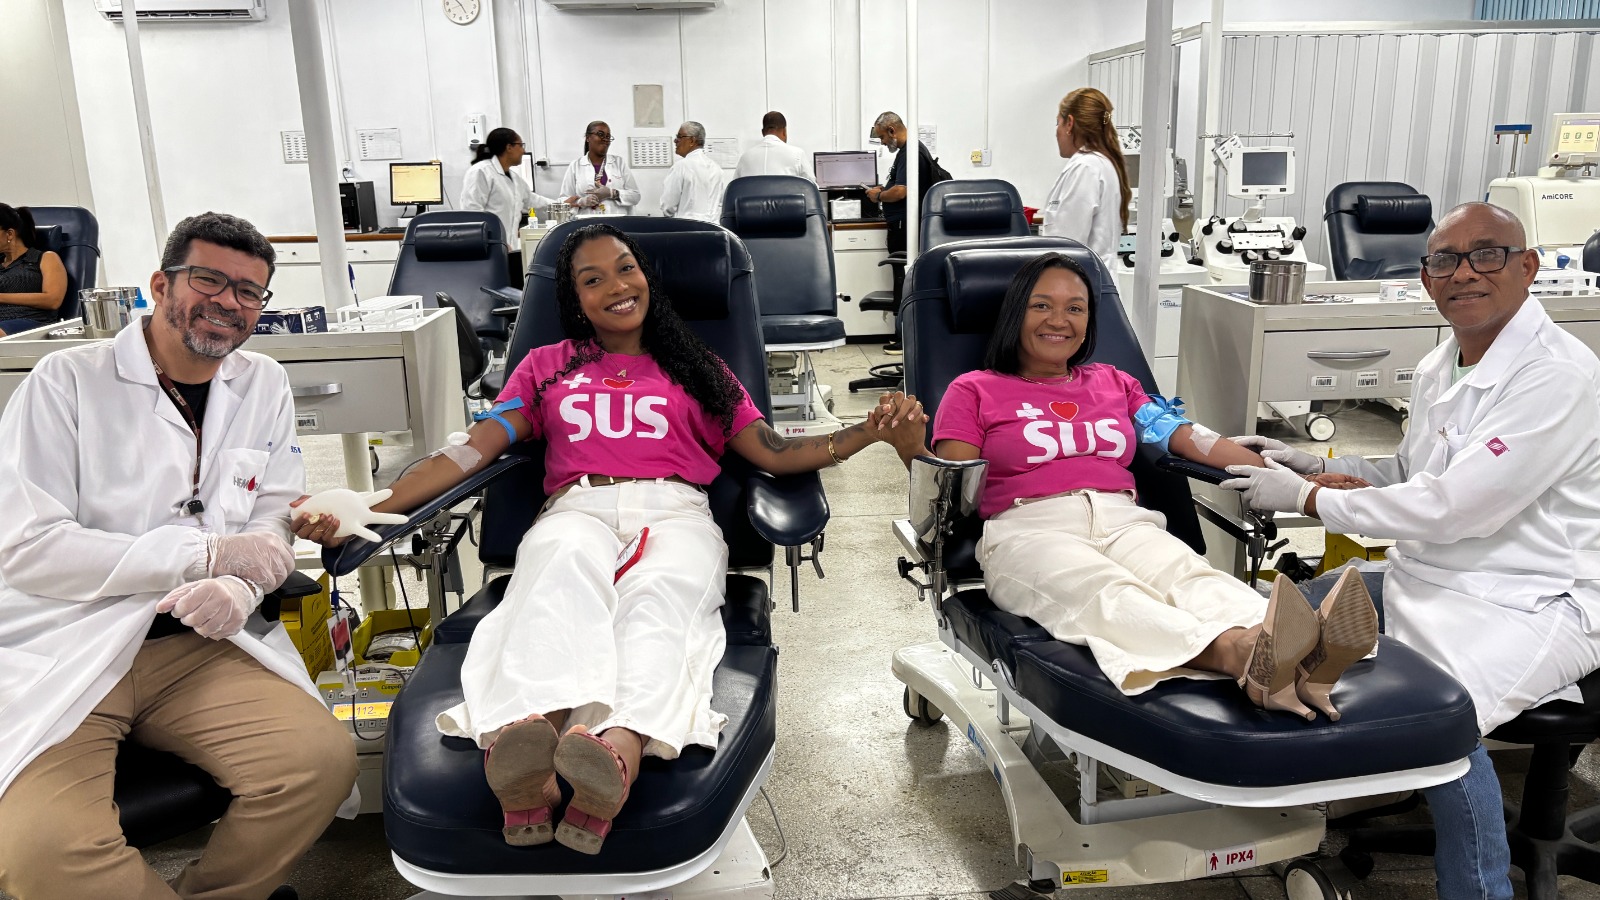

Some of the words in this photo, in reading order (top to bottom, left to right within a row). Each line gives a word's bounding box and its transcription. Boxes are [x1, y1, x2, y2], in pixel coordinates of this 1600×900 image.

[559, 393, 669, 443] SUS
[1023, 418, 1127, 464] SUS
[356, 705, 375, 716] 112
[1226, 849, 1254, 866] IPX4
